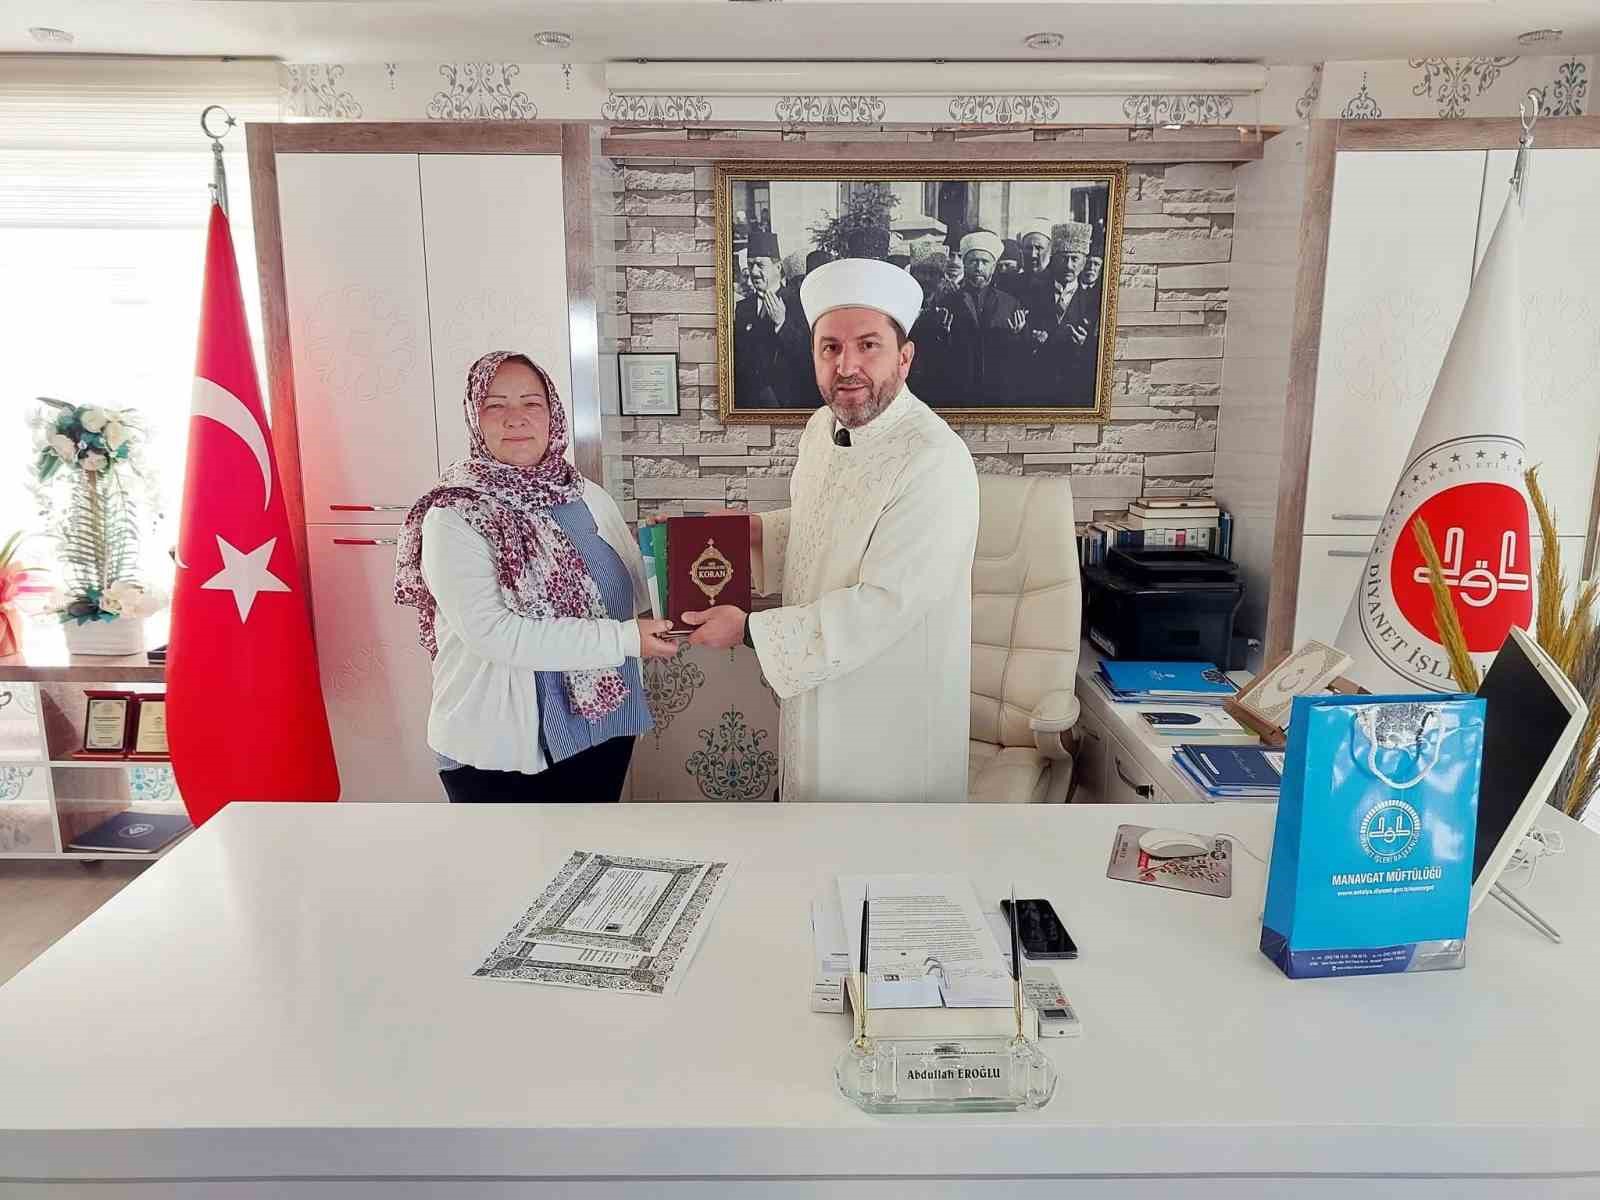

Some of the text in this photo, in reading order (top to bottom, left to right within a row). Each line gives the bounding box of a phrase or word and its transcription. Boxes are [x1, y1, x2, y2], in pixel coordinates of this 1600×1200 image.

[1367, 564, 1408, 652] DİYANET
[1332, 866, 1442, 886] MANAVGAT MÜFTÜLÜĞÜ
[906, 1066, 1001, 1080] Abdullah EROĞLU
